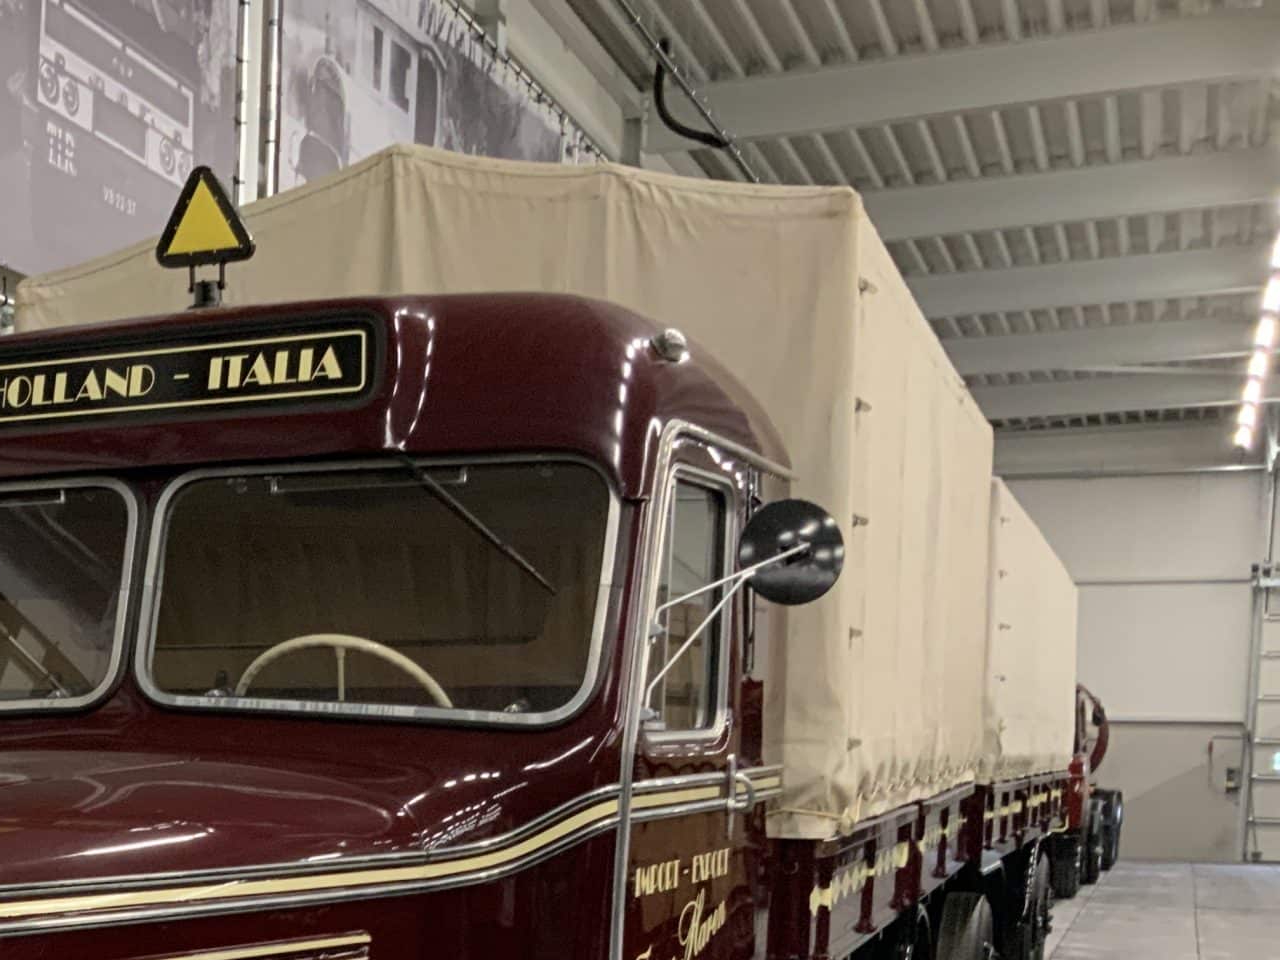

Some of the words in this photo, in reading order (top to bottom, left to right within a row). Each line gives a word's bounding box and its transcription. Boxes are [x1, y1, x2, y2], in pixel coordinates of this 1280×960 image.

[208, 344, 342, 391] ITALIA
[634, 859, 681, 898] IMPORT
[691, 847, 730, 885] EXPORT
